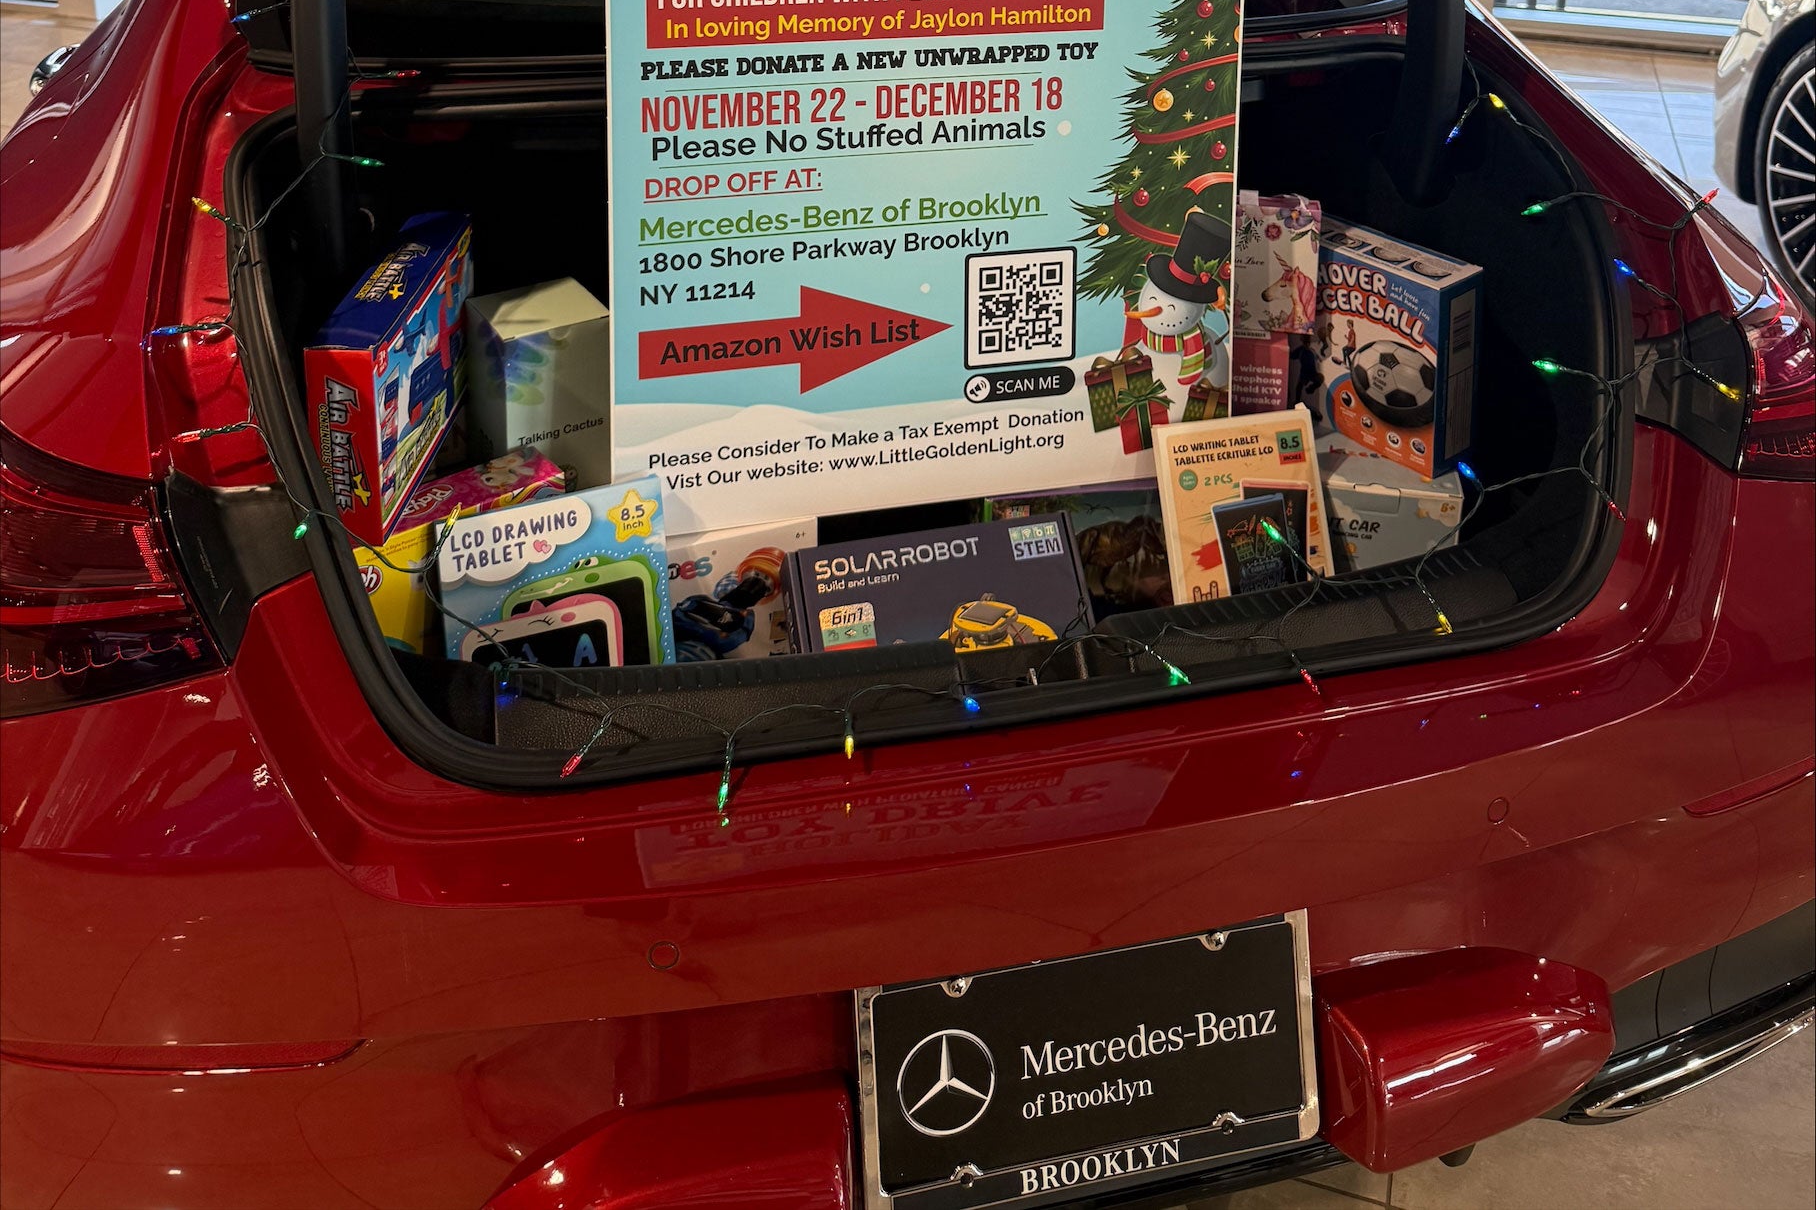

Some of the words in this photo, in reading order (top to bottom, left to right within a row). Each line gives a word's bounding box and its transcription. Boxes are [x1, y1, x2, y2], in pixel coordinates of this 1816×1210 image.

[666, 19, 690, 40] In
[696, 15, 771, 42] loving
[778, 14, 875, 38] Memory
[881, 8, 904, 32] of
[910, 7, 984, 33] Jaylon
[991, 3, 1091, 27] Hamilton
[641, 58, 729, 80] PLEASE
[736, 54, 823, 77] DONATE
[832, 53, 849, 71] A
[856, 50, 905, 69] NEW
[915, 45, 1049, 67] UNWRAPPED
[1057, 42, 1098, 61] TOY
[641, 89, 800, 133] NOVEMBER
[810, 87, 846, 122] 22
[876, 79, 1022, 119] DECEMBER
[1030, 76, 1062, 110] 18
[651, 135, 757, 162] Please
[766, 130, 806, 154] No
[816, 121, 924, 151] Stuffed
[932, 115, 1046, 143] Animals
[645, 174, 720, 200] DROP
[727, 171, 778, 193] OFF
[785, 168, 822, 190] AT:
[640, 205, 873, 242] Mercedes-Benz
[882, 200, 910, 224] of
[919, 192, 1041, 223] Brooklyn
[640, 252, 702, 274] 1800
[710, 243, 784, 268] Shore
[793, 237, 897, 259] Parkway
[904, 226, 1009, 252] Brooklyn
[640, 285, 676, 306] NY
[685, 281, 755, 302] 11214
[1391, 283, 1403, 294] Let
[1368, 296, 1424, 342] BALL
[1404, 297, 1419, 311] have
[1419, 308, 1430, 321] fun
[661, 334, 781, 365] Amazon
[790, 324, 862, 354] Wish
[871, 319, 920, 344] List
[995, 377, 1035, 393] SCAN
[1039, 375, 1060, 390] ME
[1233, 375, 1282, 385] crophone
[1240, 365, 1283, 375] wireless
[325, 375, 360, 425] AIR
[1240, 396, 1281, 405] speaker
[1262, 386, 1281, 395] KTV
[319, 404, 332, 467] CONTINUOUS
[518, 429, 560, 447] Talking
[563, 417, 604, 434] Cactus
[649, 452, 712, 469] Please
[717, 439, 800, 460] Consider
[806, 436, 826, 451] To
[832, 430, 879, 448] Make
[884, 432, 893, 442] a
[900, 425, 927, 440] Tax
[934, 417, 1000, 435] Exempt
[1008, 408, 1084, 426] Donation
[1173, 444, 1188, 454] LCD
[1190, 439, 1227, 452] WRITING
[1229, 435, 1260, 448] TABLET
[1280, 436, 1300, 450] 8.5
[667, 473, 702, 490] Vist
[708, 469, 740, 485] Our
[746, 460, 823, 479] website:
[829, 433, 1064, 471] www.LittleGoldenLight.org
[1174, 453, 1215, 466] TABLETTE
[1217, 448, 1257, 461] ECRITURE
[1258, 446, 1274, 455] LCD
[330, 430, 355, 513] BATTLE
[1204, 476, 1211, 486] 2
[1214, 473, 1233, 484] PCS
[620, 504, 645, 521] 8.5
[1440, 503, 1456, 513] 6+
[451, 529, 485, 553] LCD
[492, 510, 578, 543] DRAWING
[622, 520, 644, 531] inch
[1349, 519, 1381, 534] CAR
[452, 542, 526, 573] TABLET
[1014, 538, 1061, 558] STEM
[817, 579, 845, 594] Build
[848, 578, 865, 588] and
[867, 572, 900, 585] Learn
[832, 606, 863, 626] 6in1
[1020, 1008, 1277, 1080] Mercedes-Benz
[1022, 1095, 1045, 1120] of
[1050, 1076, 1154, 1116] Brooklyn
[1020, 1138, 1181, 1195] BROOKLYN
